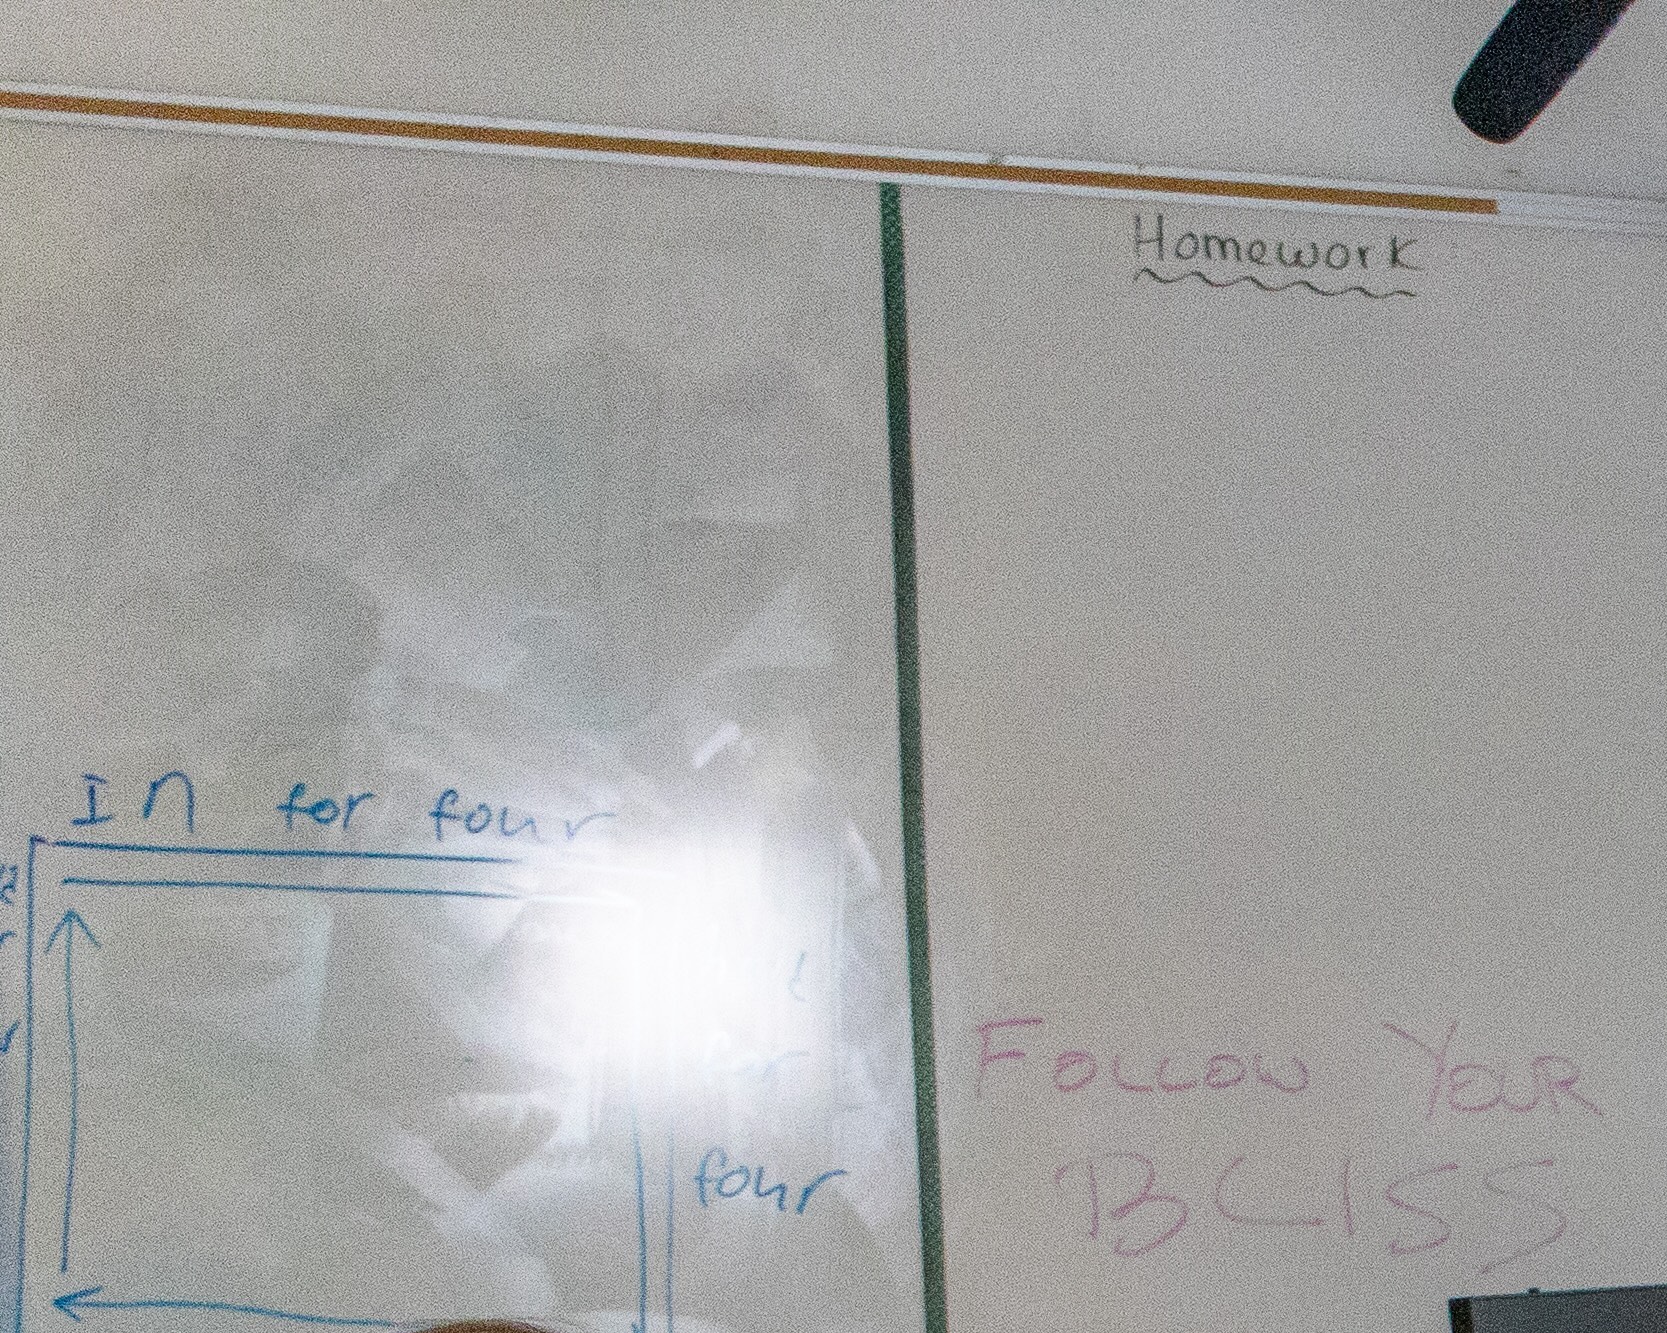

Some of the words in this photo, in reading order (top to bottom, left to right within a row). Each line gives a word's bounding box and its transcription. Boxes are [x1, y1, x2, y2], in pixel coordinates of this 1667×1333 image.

[1131, 212, 1426, 274] Homework
[277, 783, 376, 843] for
[428, 789, 622, 843] four
[693, 1145, 848, 1215] four
